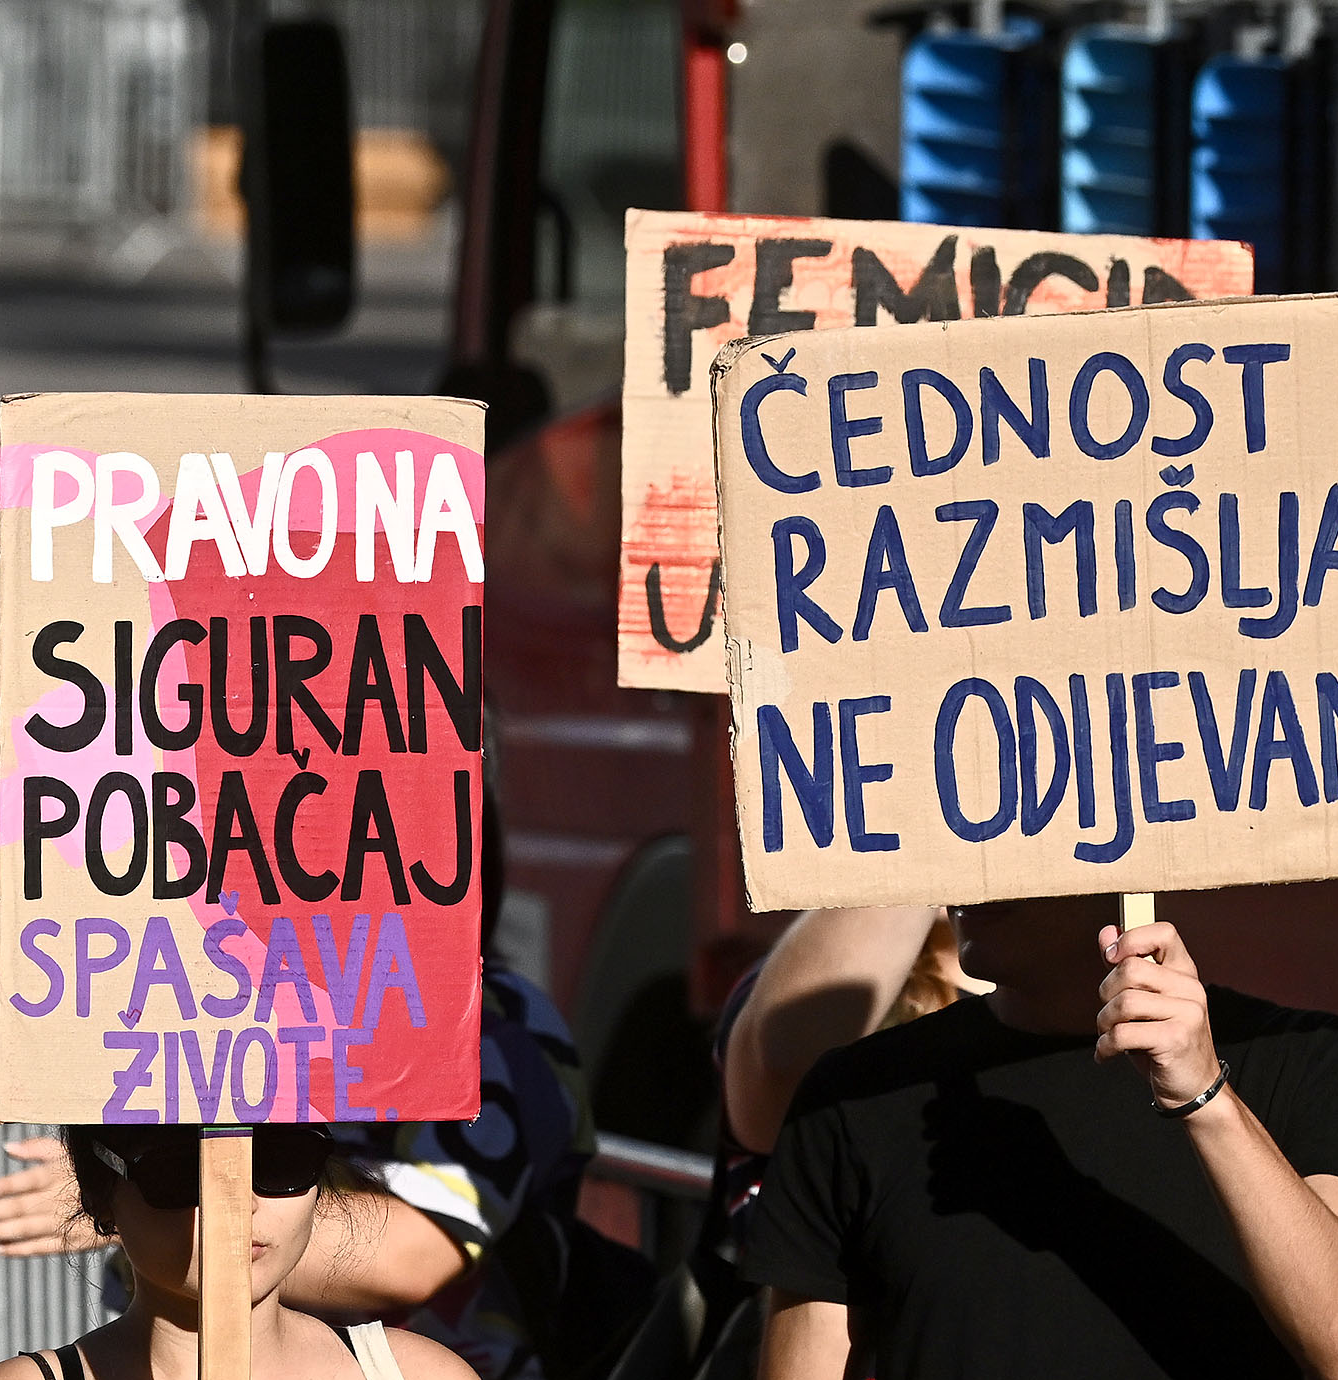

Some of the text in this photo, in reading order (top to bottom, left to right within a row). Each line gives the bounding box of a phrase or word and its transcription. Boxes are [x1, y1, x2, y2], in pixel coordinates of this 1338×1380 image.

[740, 341, 1290, 494] ČEDNOST
[29, 447, 485, 584] PRAVO NA
[23, 605, 483, 757] SIGURAN
[22, 747, 472, 906] POBAČAJ
[757, 694, 901, 854] NE
[9, 890, 427, 1028] SPAŠAVA
